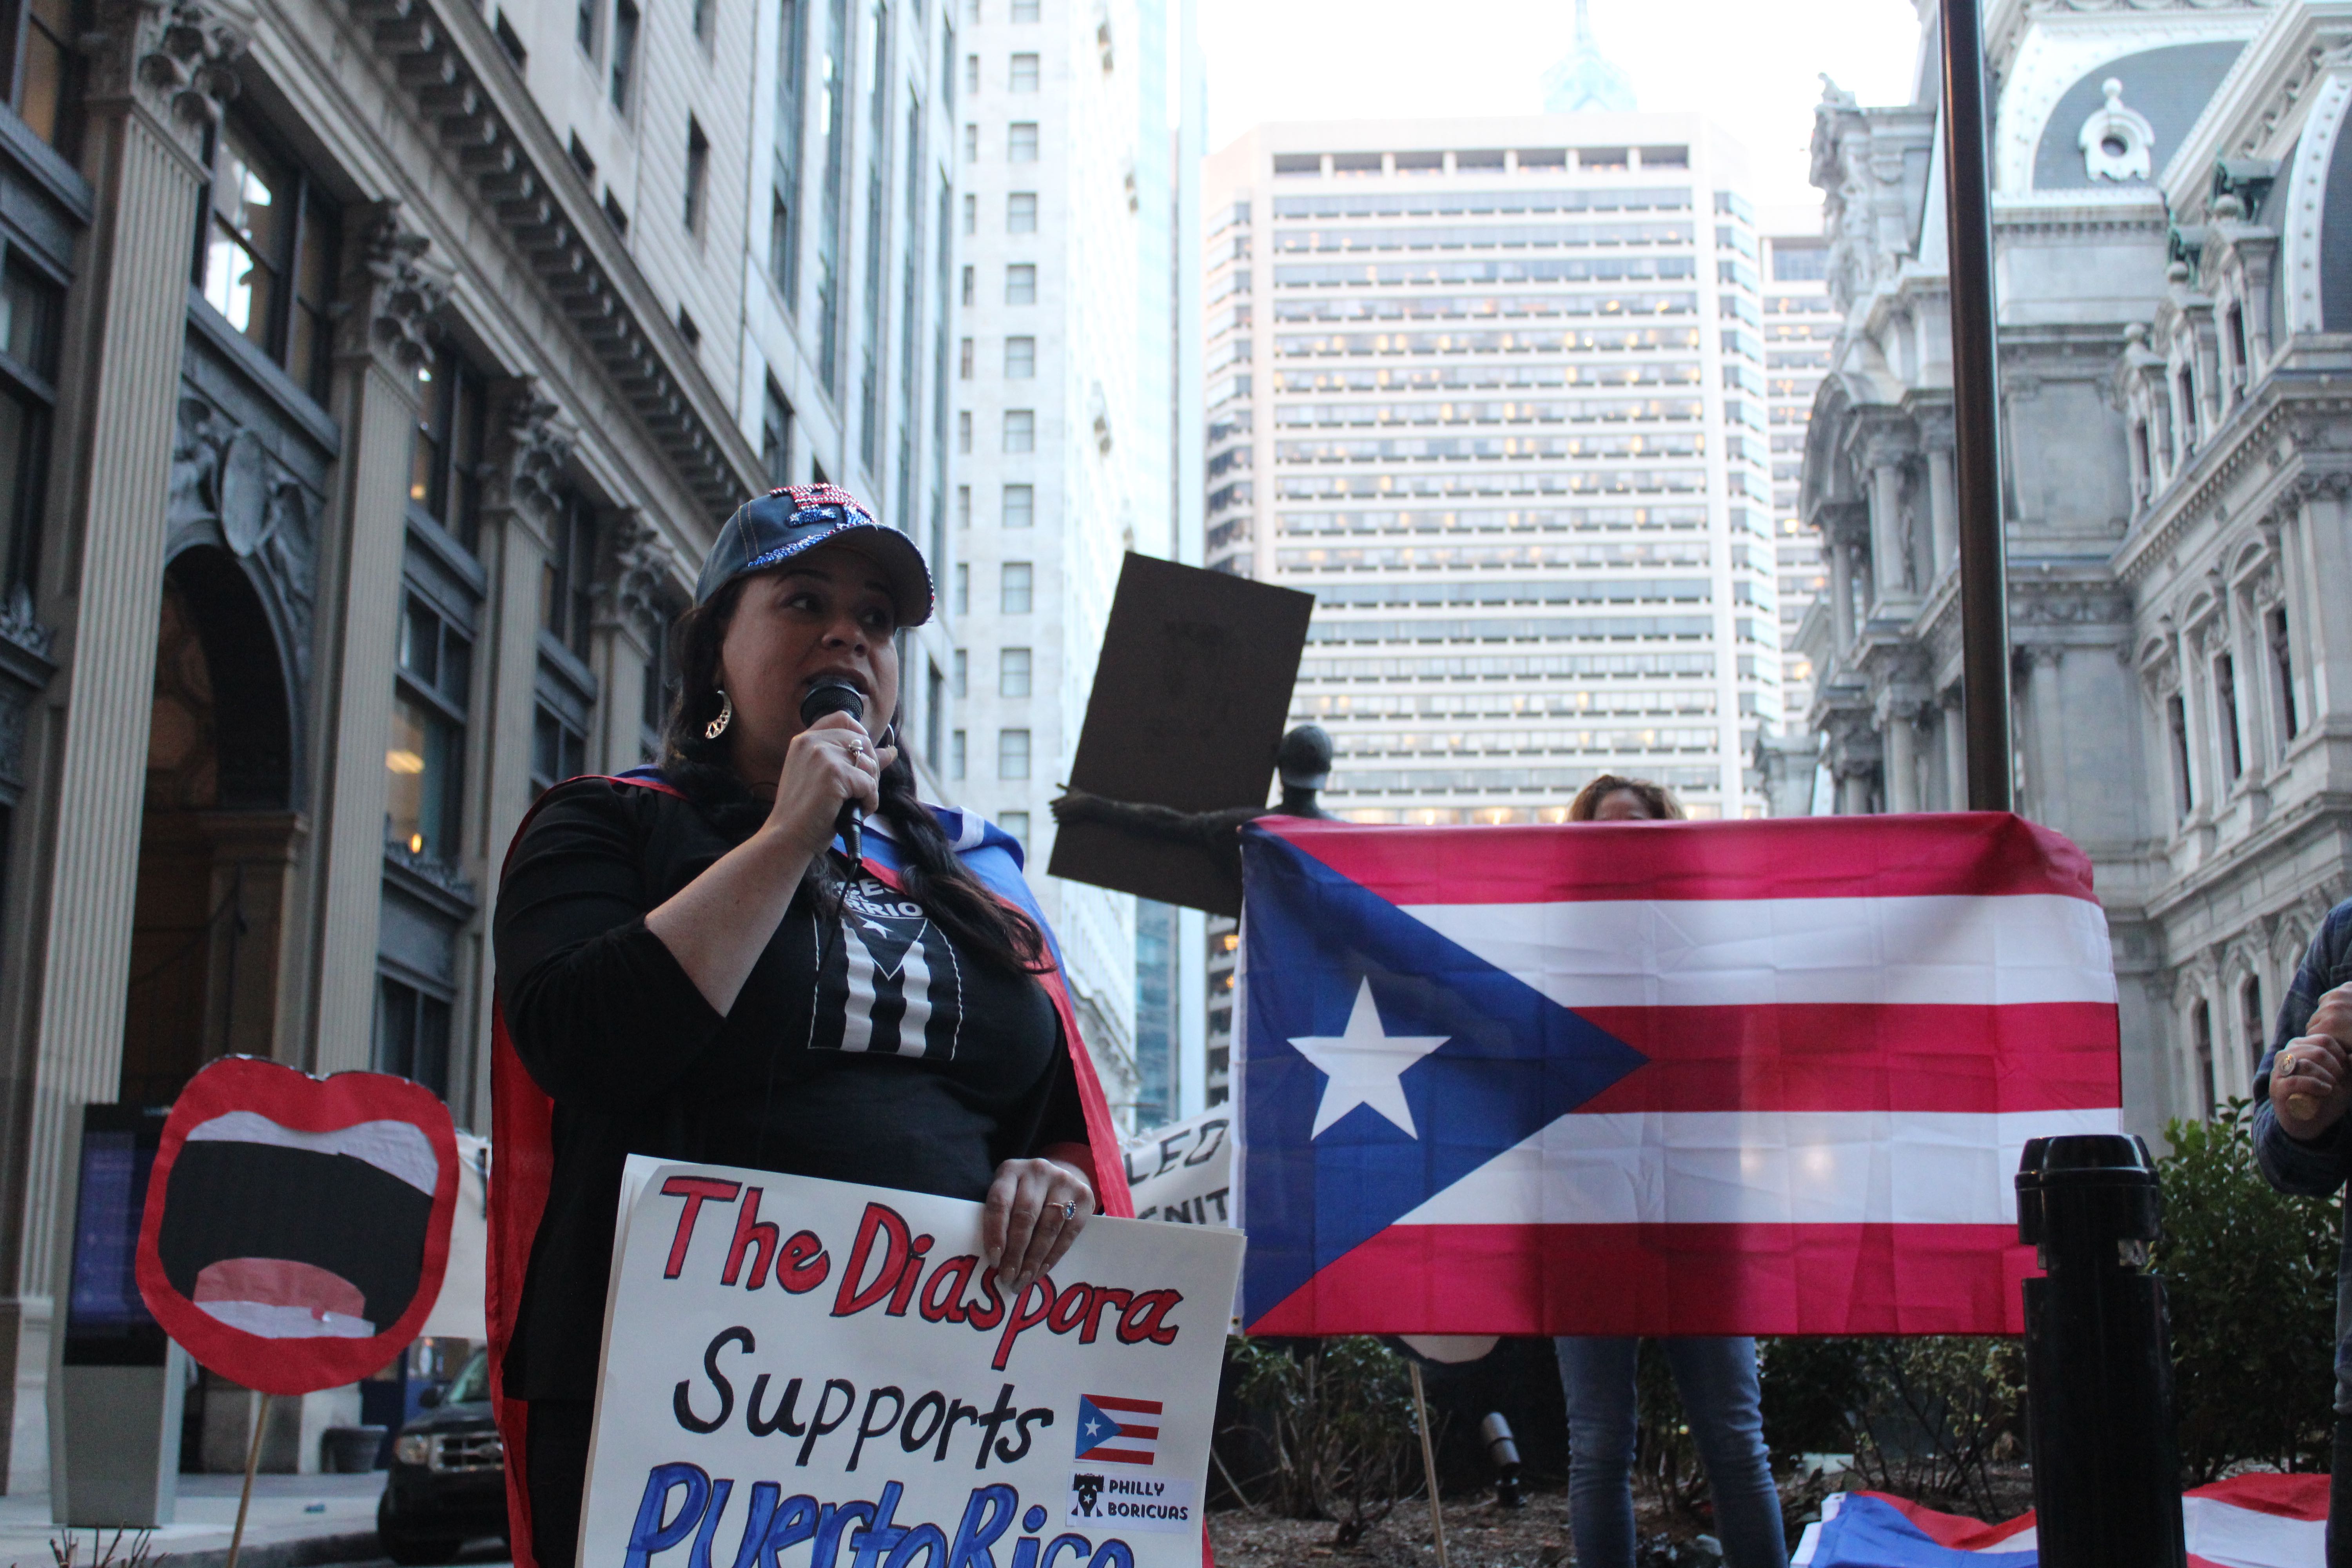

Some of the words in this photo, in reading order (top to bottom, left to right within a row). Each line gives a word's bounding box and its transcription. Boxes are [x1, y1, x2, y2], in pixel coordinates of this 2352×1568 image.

[843, 898, 923, 917] RRIO
[660, 1175, 831, 1295] The
[830, 1201, 1182, 1372] Diaspora
[673, 1326, 1053, 1472] Supports
[1109, 1479, 1165, 1496] PHILLY
[1108, 1501, 1188, 1520] BORICUAS
